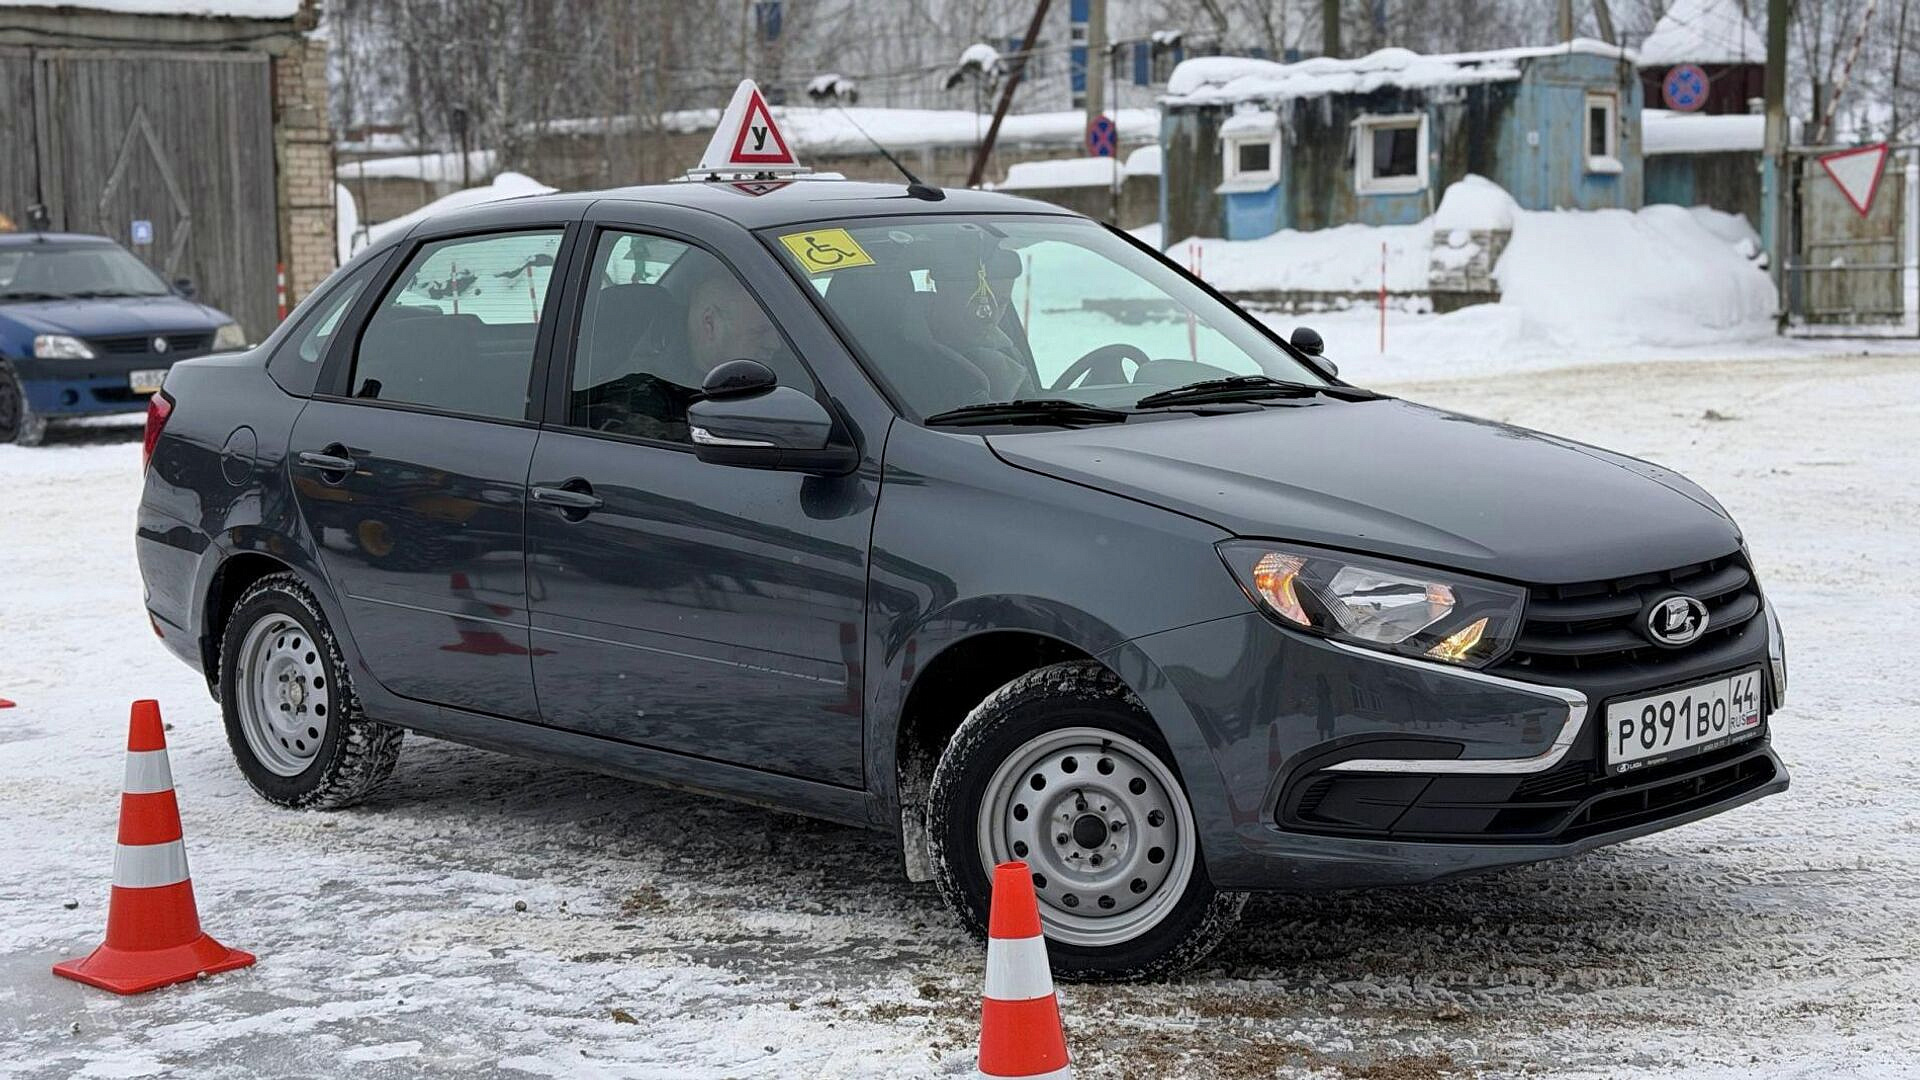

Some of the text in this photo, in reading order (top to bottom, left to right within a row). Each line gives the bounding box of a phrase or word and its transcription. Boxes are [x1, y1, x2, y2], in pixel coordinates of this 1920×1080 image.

[751, 126, 768, 151] У
[1732, 676, 1754, 713] 44
[1730, 714, 1746, 729] RUS
